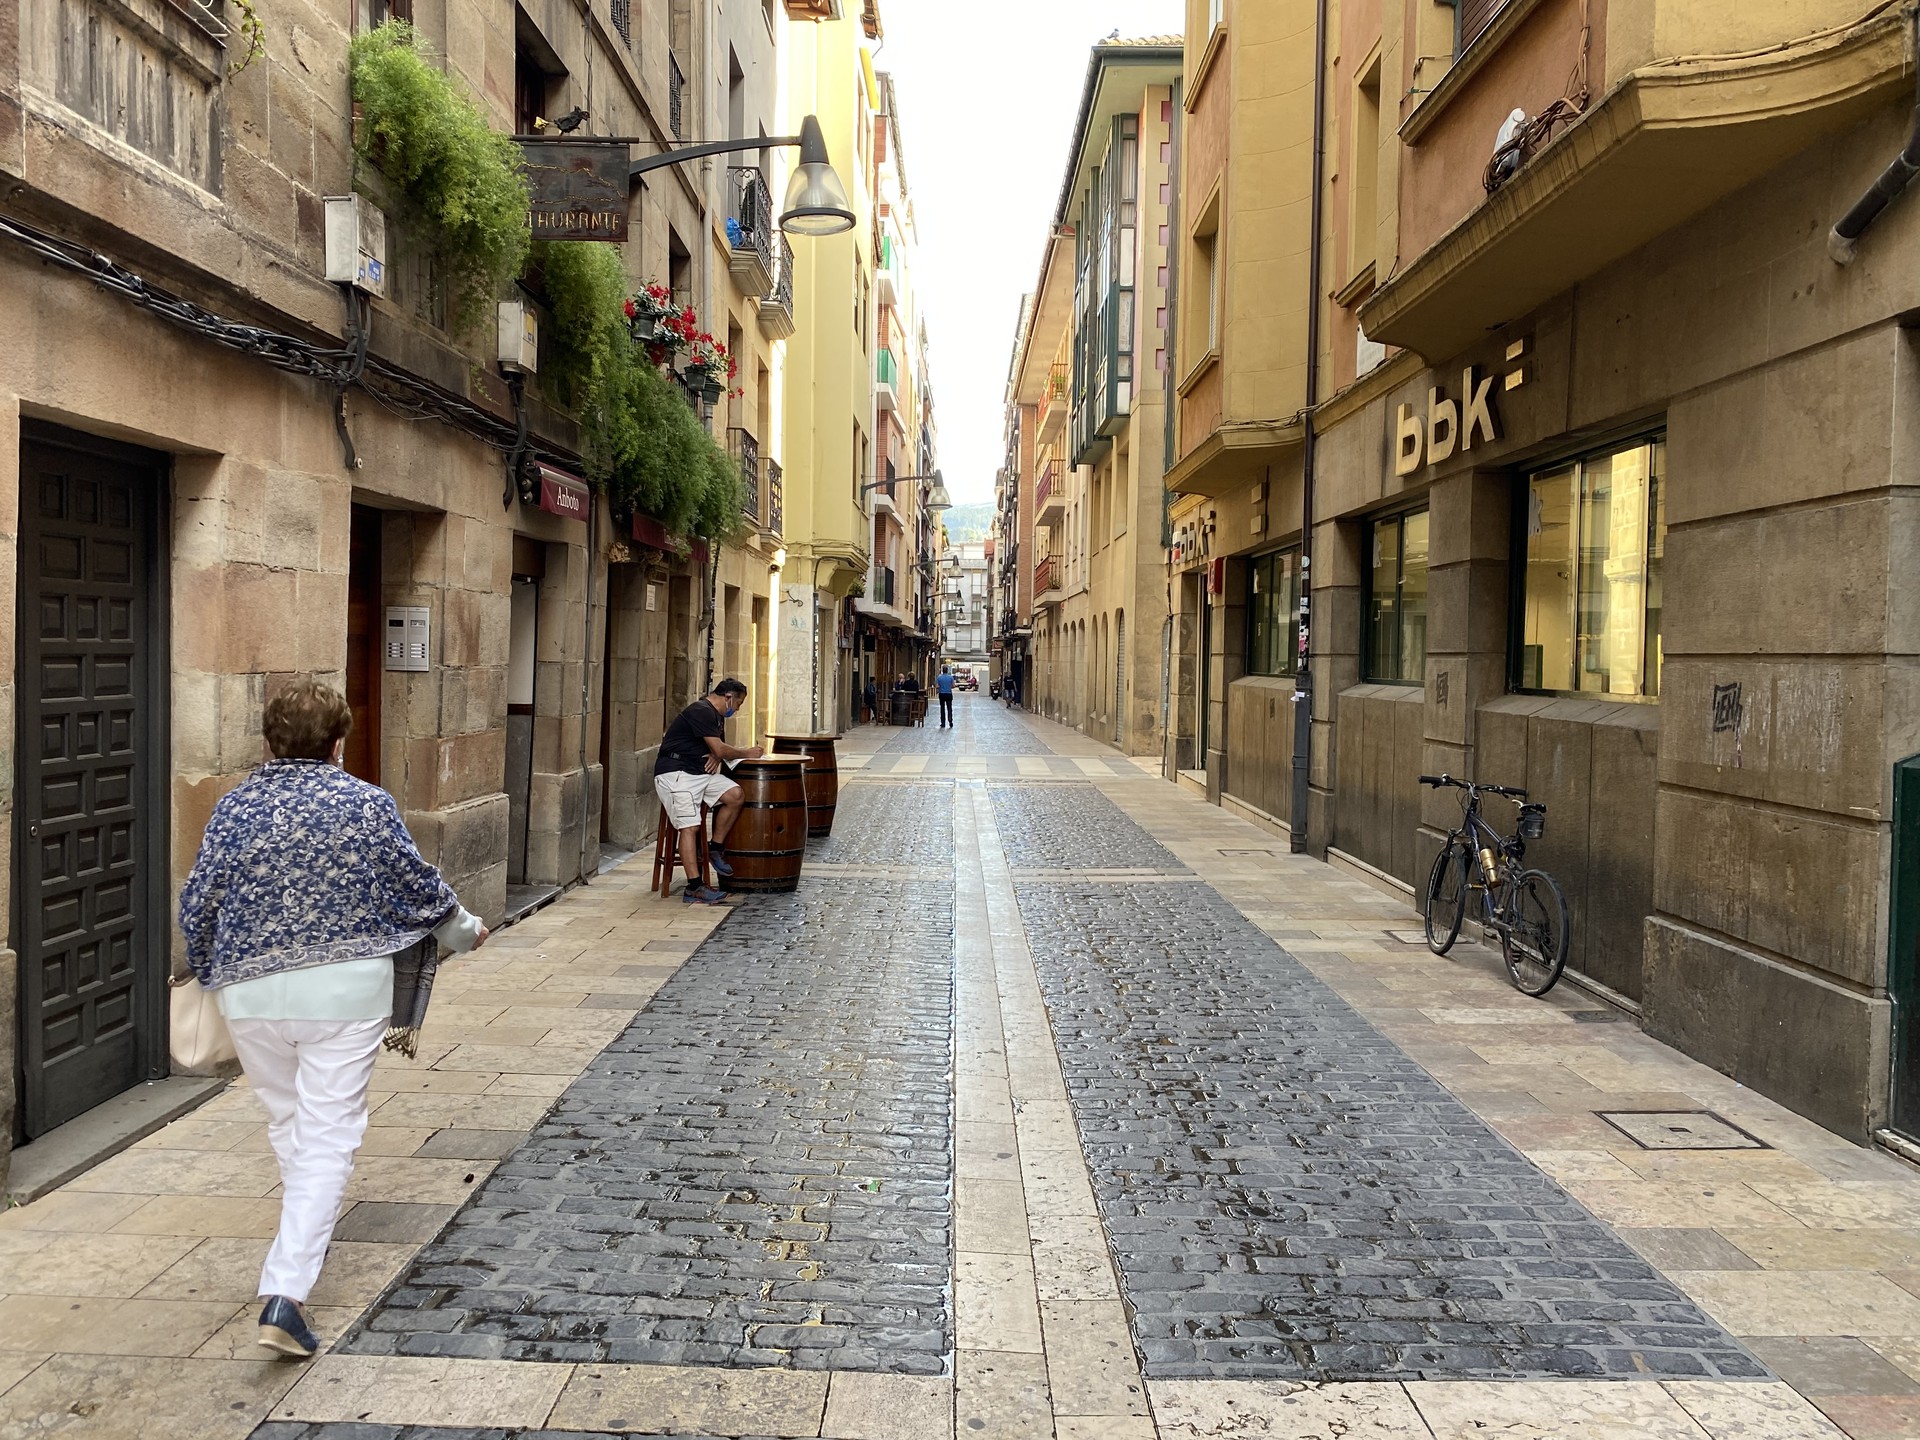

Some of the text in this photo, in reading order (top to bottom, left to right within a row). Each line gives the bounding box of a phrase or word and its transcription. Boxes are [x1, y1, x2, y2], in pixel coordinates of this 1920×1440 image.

[521, 210, 621, 231] TAURANTE
[1396, 366, 1496, 477] bbk
[557, 486, 580, 511] Anboto
